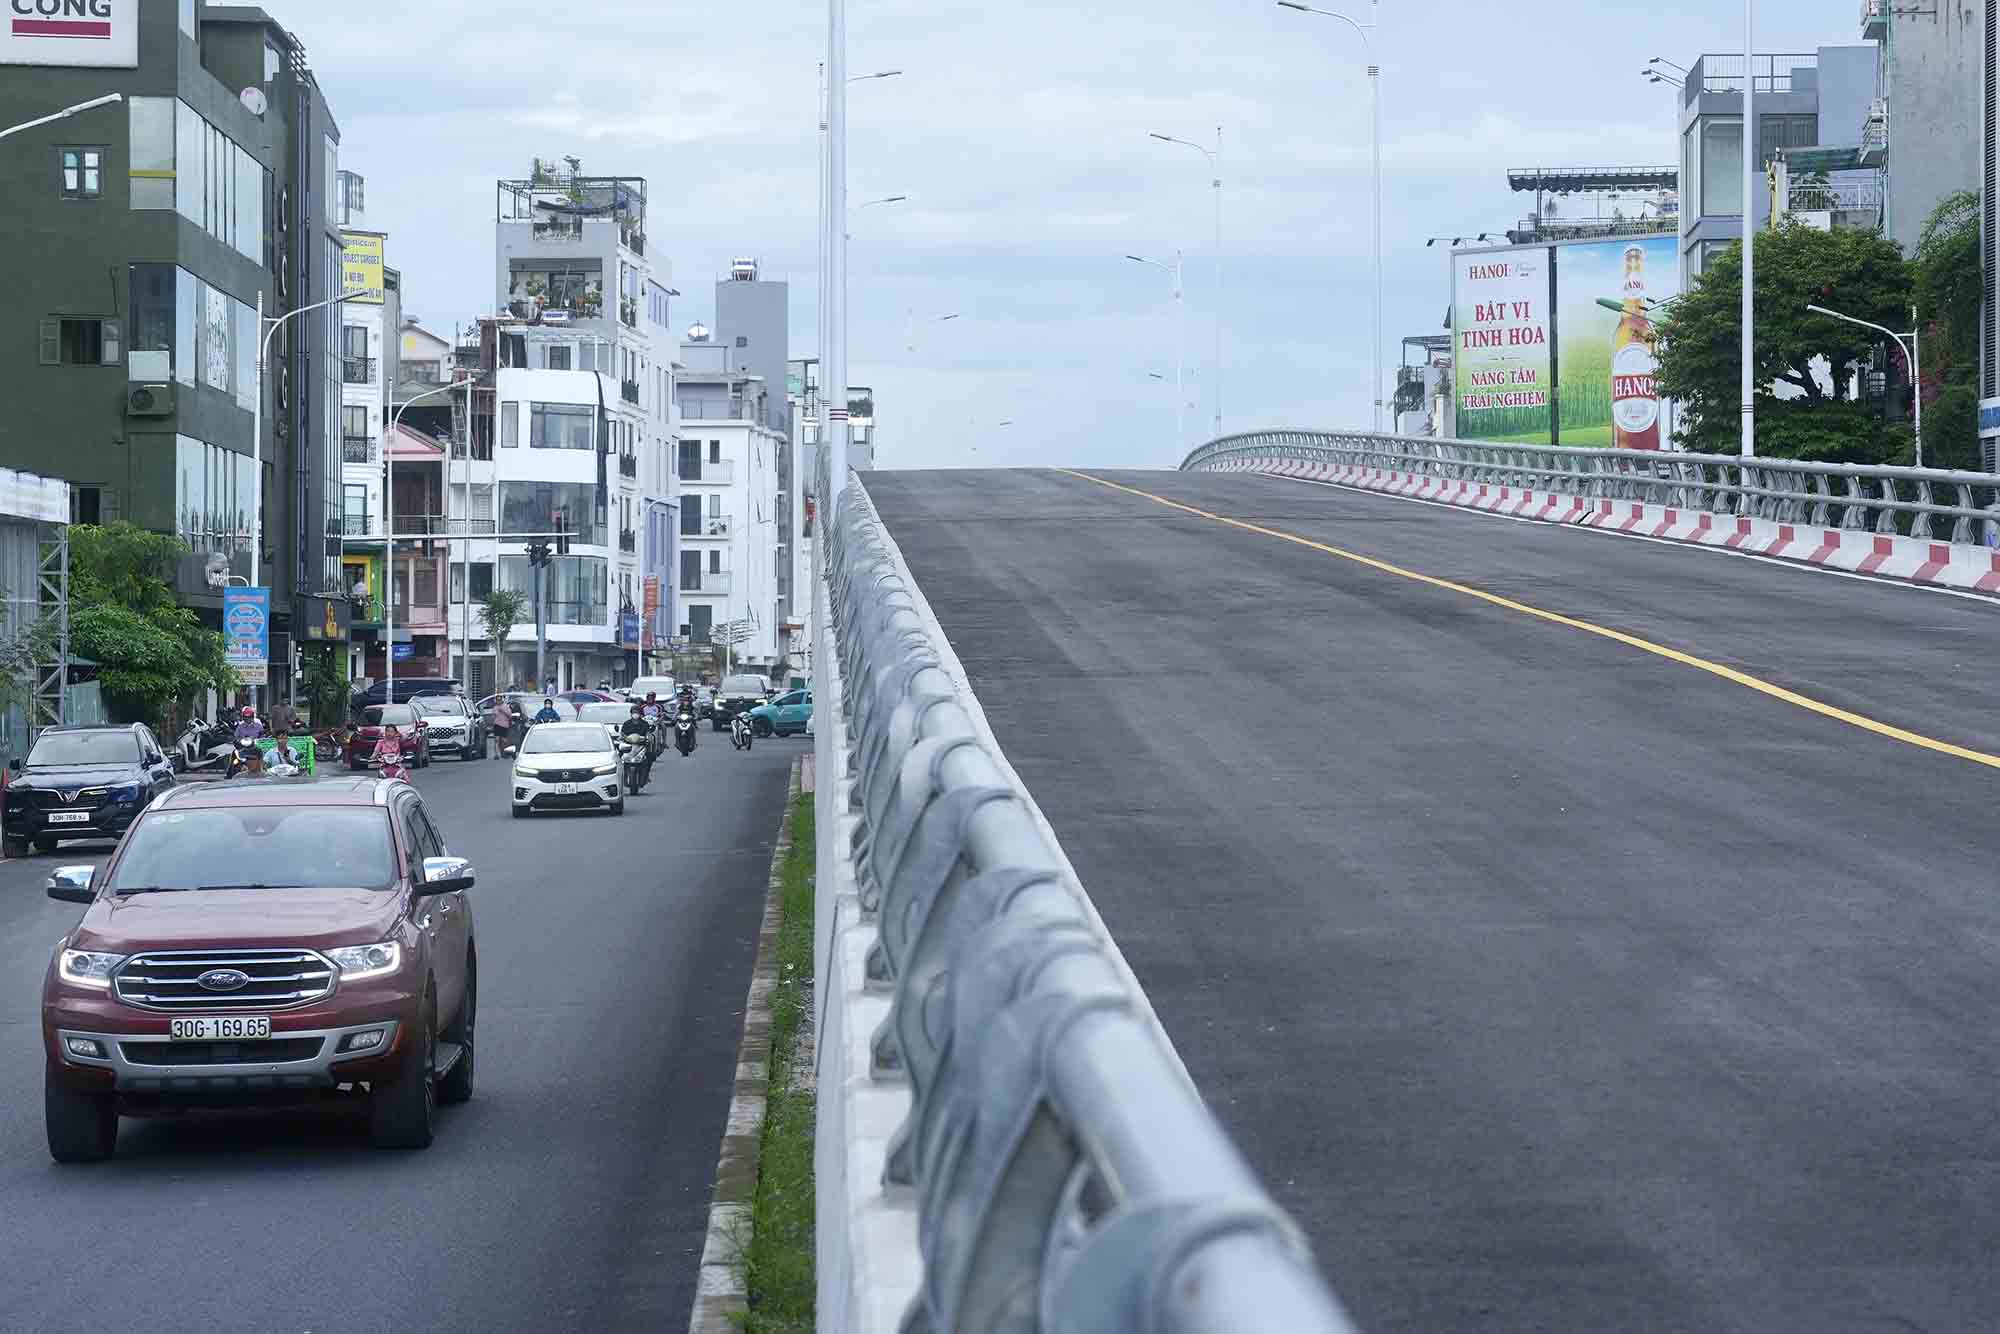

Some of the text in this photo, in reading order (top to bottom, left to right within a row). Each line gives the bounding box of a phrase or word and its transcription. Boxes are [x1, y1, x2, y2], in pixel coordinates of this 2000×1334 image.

[1475, 300, 1531, 325] BẬT VỊ
[1461, 326, 1545, 349] TINH HOA
[209, 973, 237, 985] Ford
[173, 1018, 268, 1038] 30G-169.65
